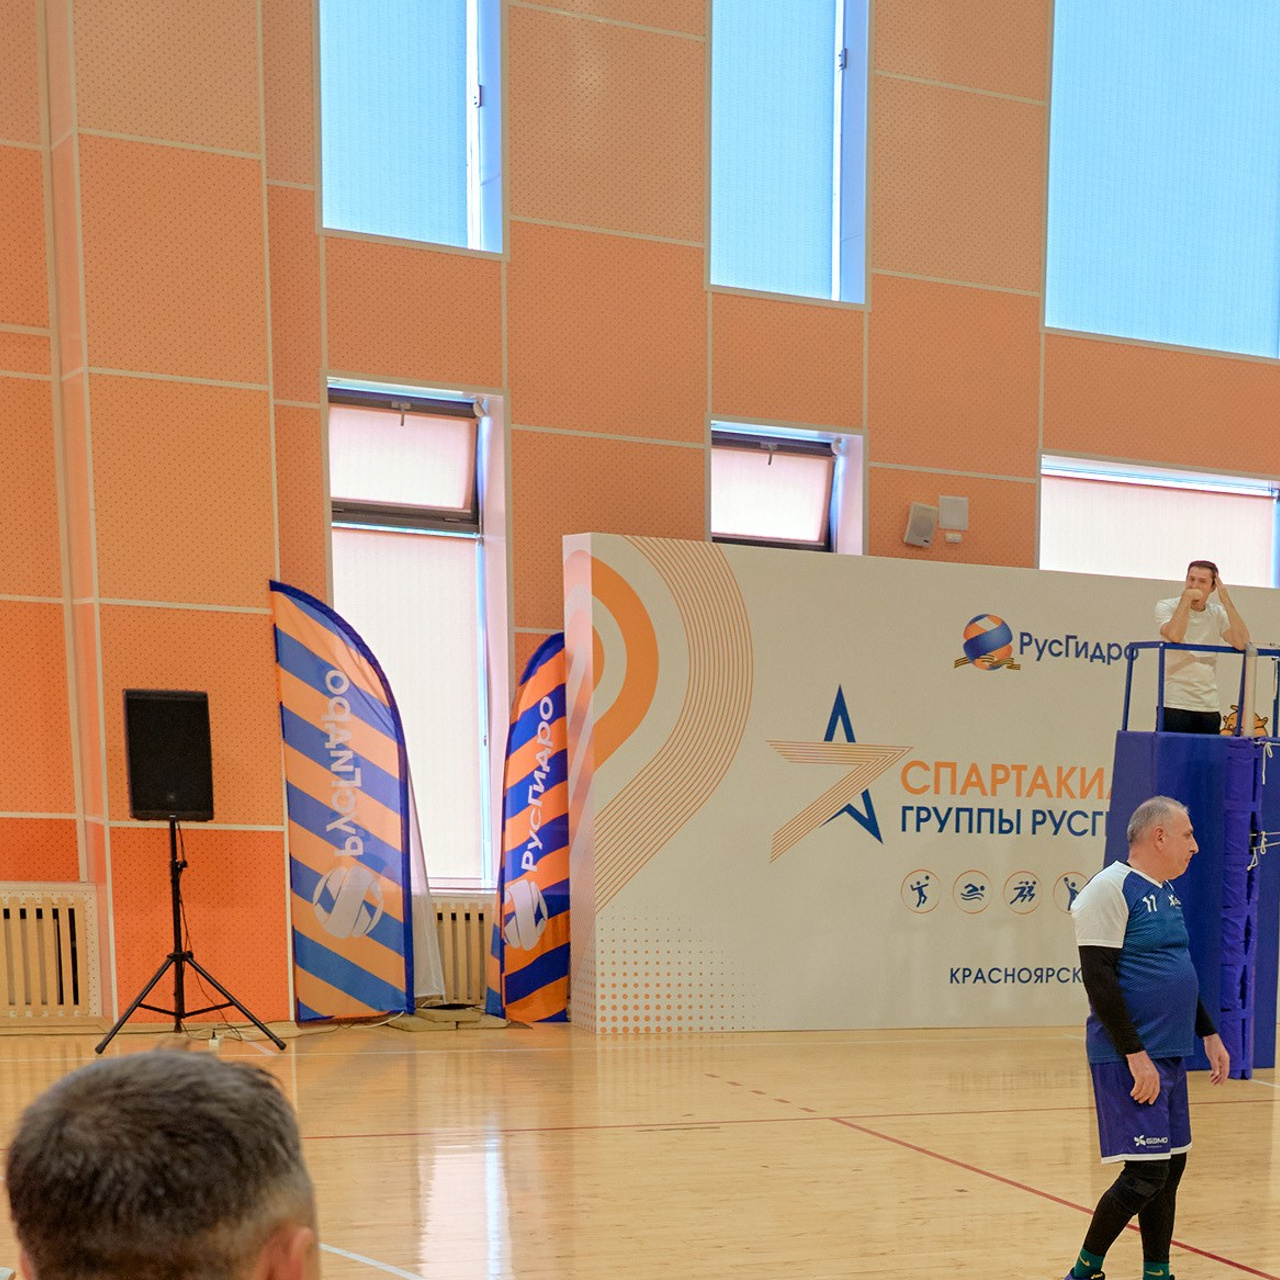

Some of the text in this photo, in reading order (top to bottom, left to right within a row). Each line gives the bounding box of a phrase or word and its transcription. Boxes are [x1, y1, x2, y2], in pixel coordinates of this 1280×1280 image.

[1020, 632, 1139, 665] РусГидро
[901, 760, 1111, 800] СПАРТАКИ
[902, 806, 1109, 837] ГРУППЫ РУСГ
[1143, 894, 1157, 912] 11
[949, 967, 1082, 984] КРАСНОЯРСК
